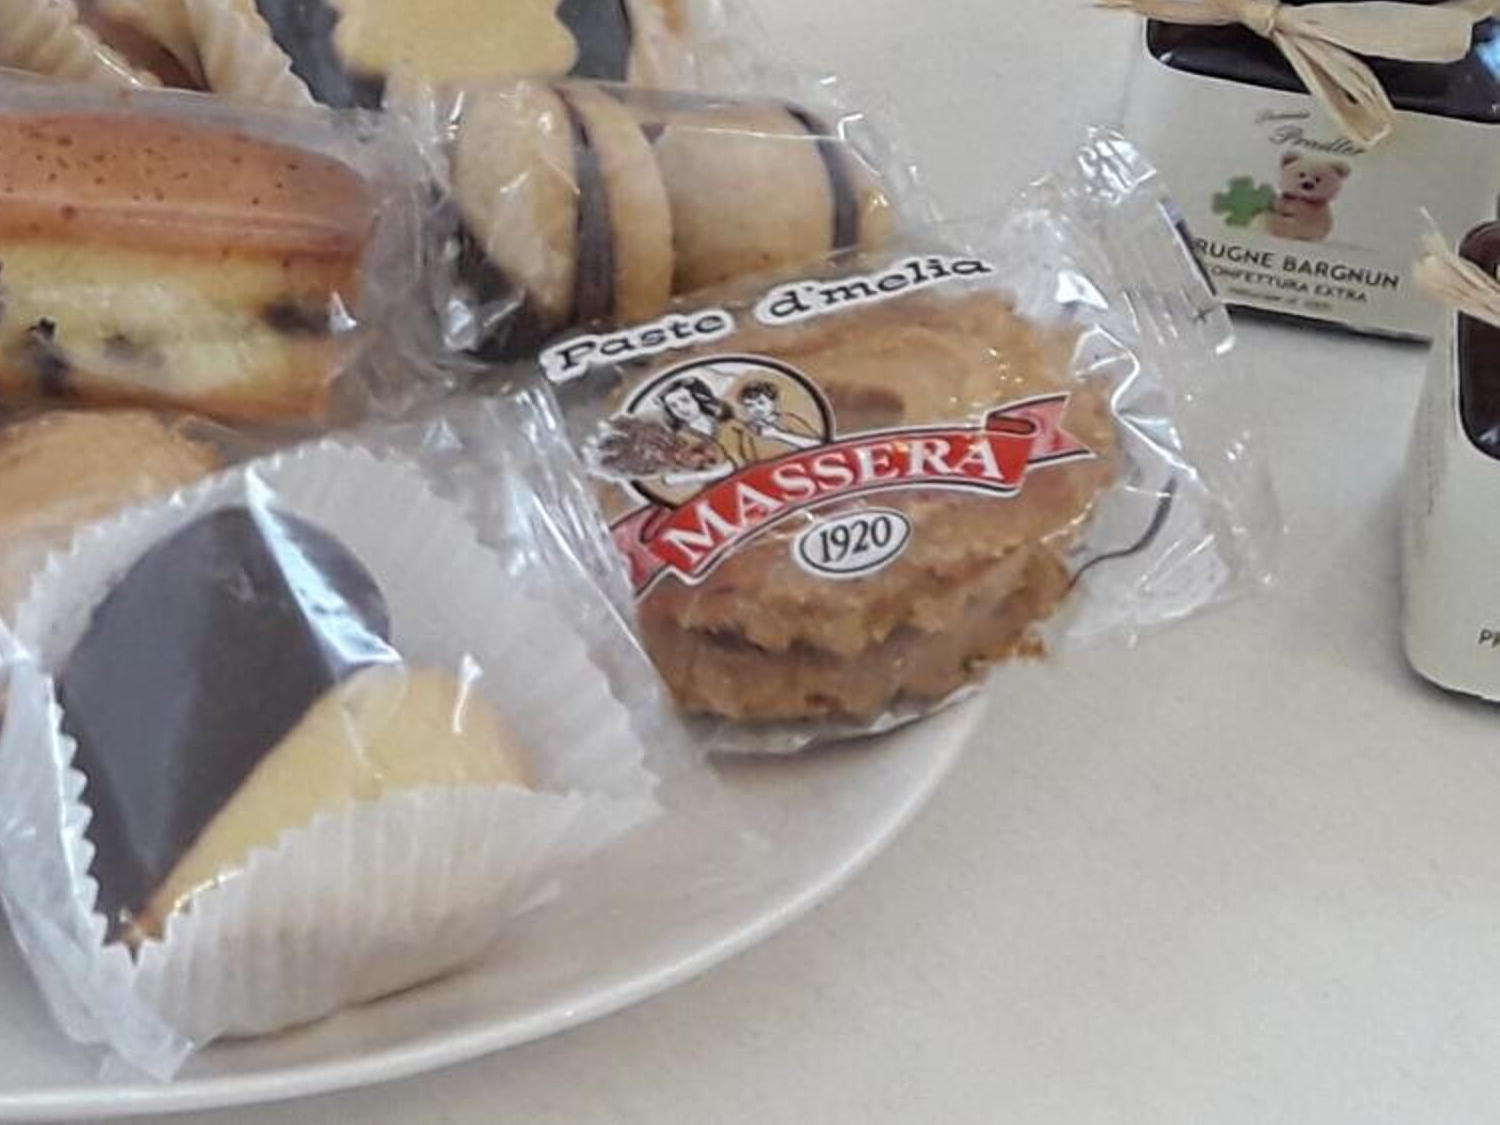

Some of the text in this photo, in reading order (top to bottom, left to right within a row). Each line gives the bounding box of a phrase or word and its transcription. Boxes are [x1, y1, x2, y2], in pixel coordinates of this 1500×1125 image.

[1192, 238, 1399, 290] RUGNE BARGNUN
[1206, 265, 1309, 292] ONFETTURA
[1315, 283, 1367, 303] EXTRA
[555, 258, 991, 371] Paste d'melia
[664, 436, 1006, 568] MASSERA
[817, 517, 894, 563] 1920
